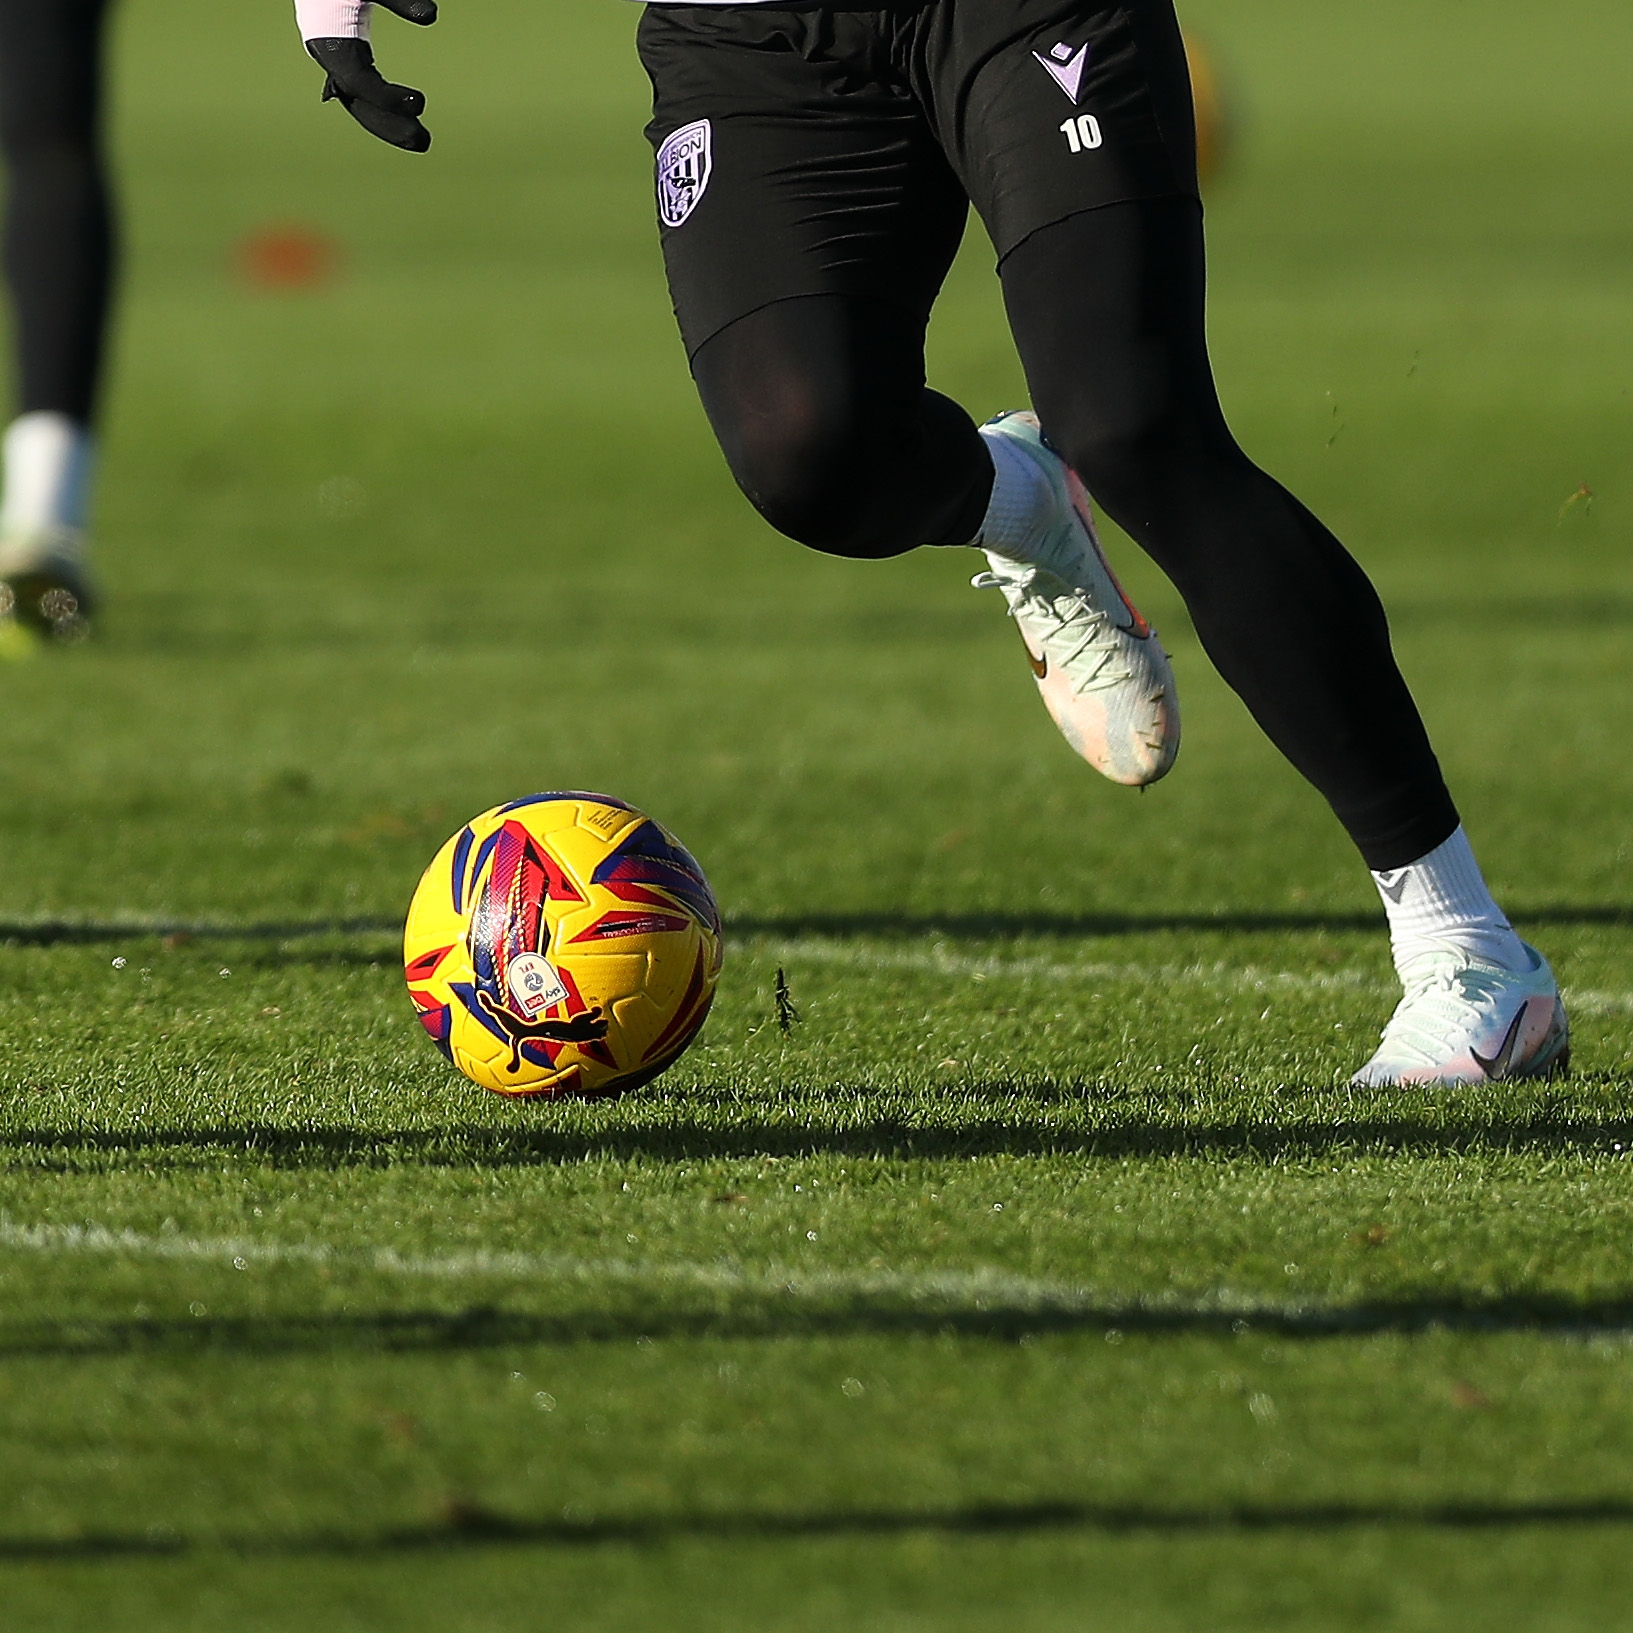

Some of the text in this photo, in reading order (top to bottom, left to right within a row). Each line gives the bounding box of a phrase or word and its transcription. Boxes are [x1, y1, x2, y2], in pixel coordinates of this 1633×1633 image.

[1059, 114, 1103, 153] 10
[518, 962, 535, 974] EFL
[525, 986, 561, 1009] sky bet
